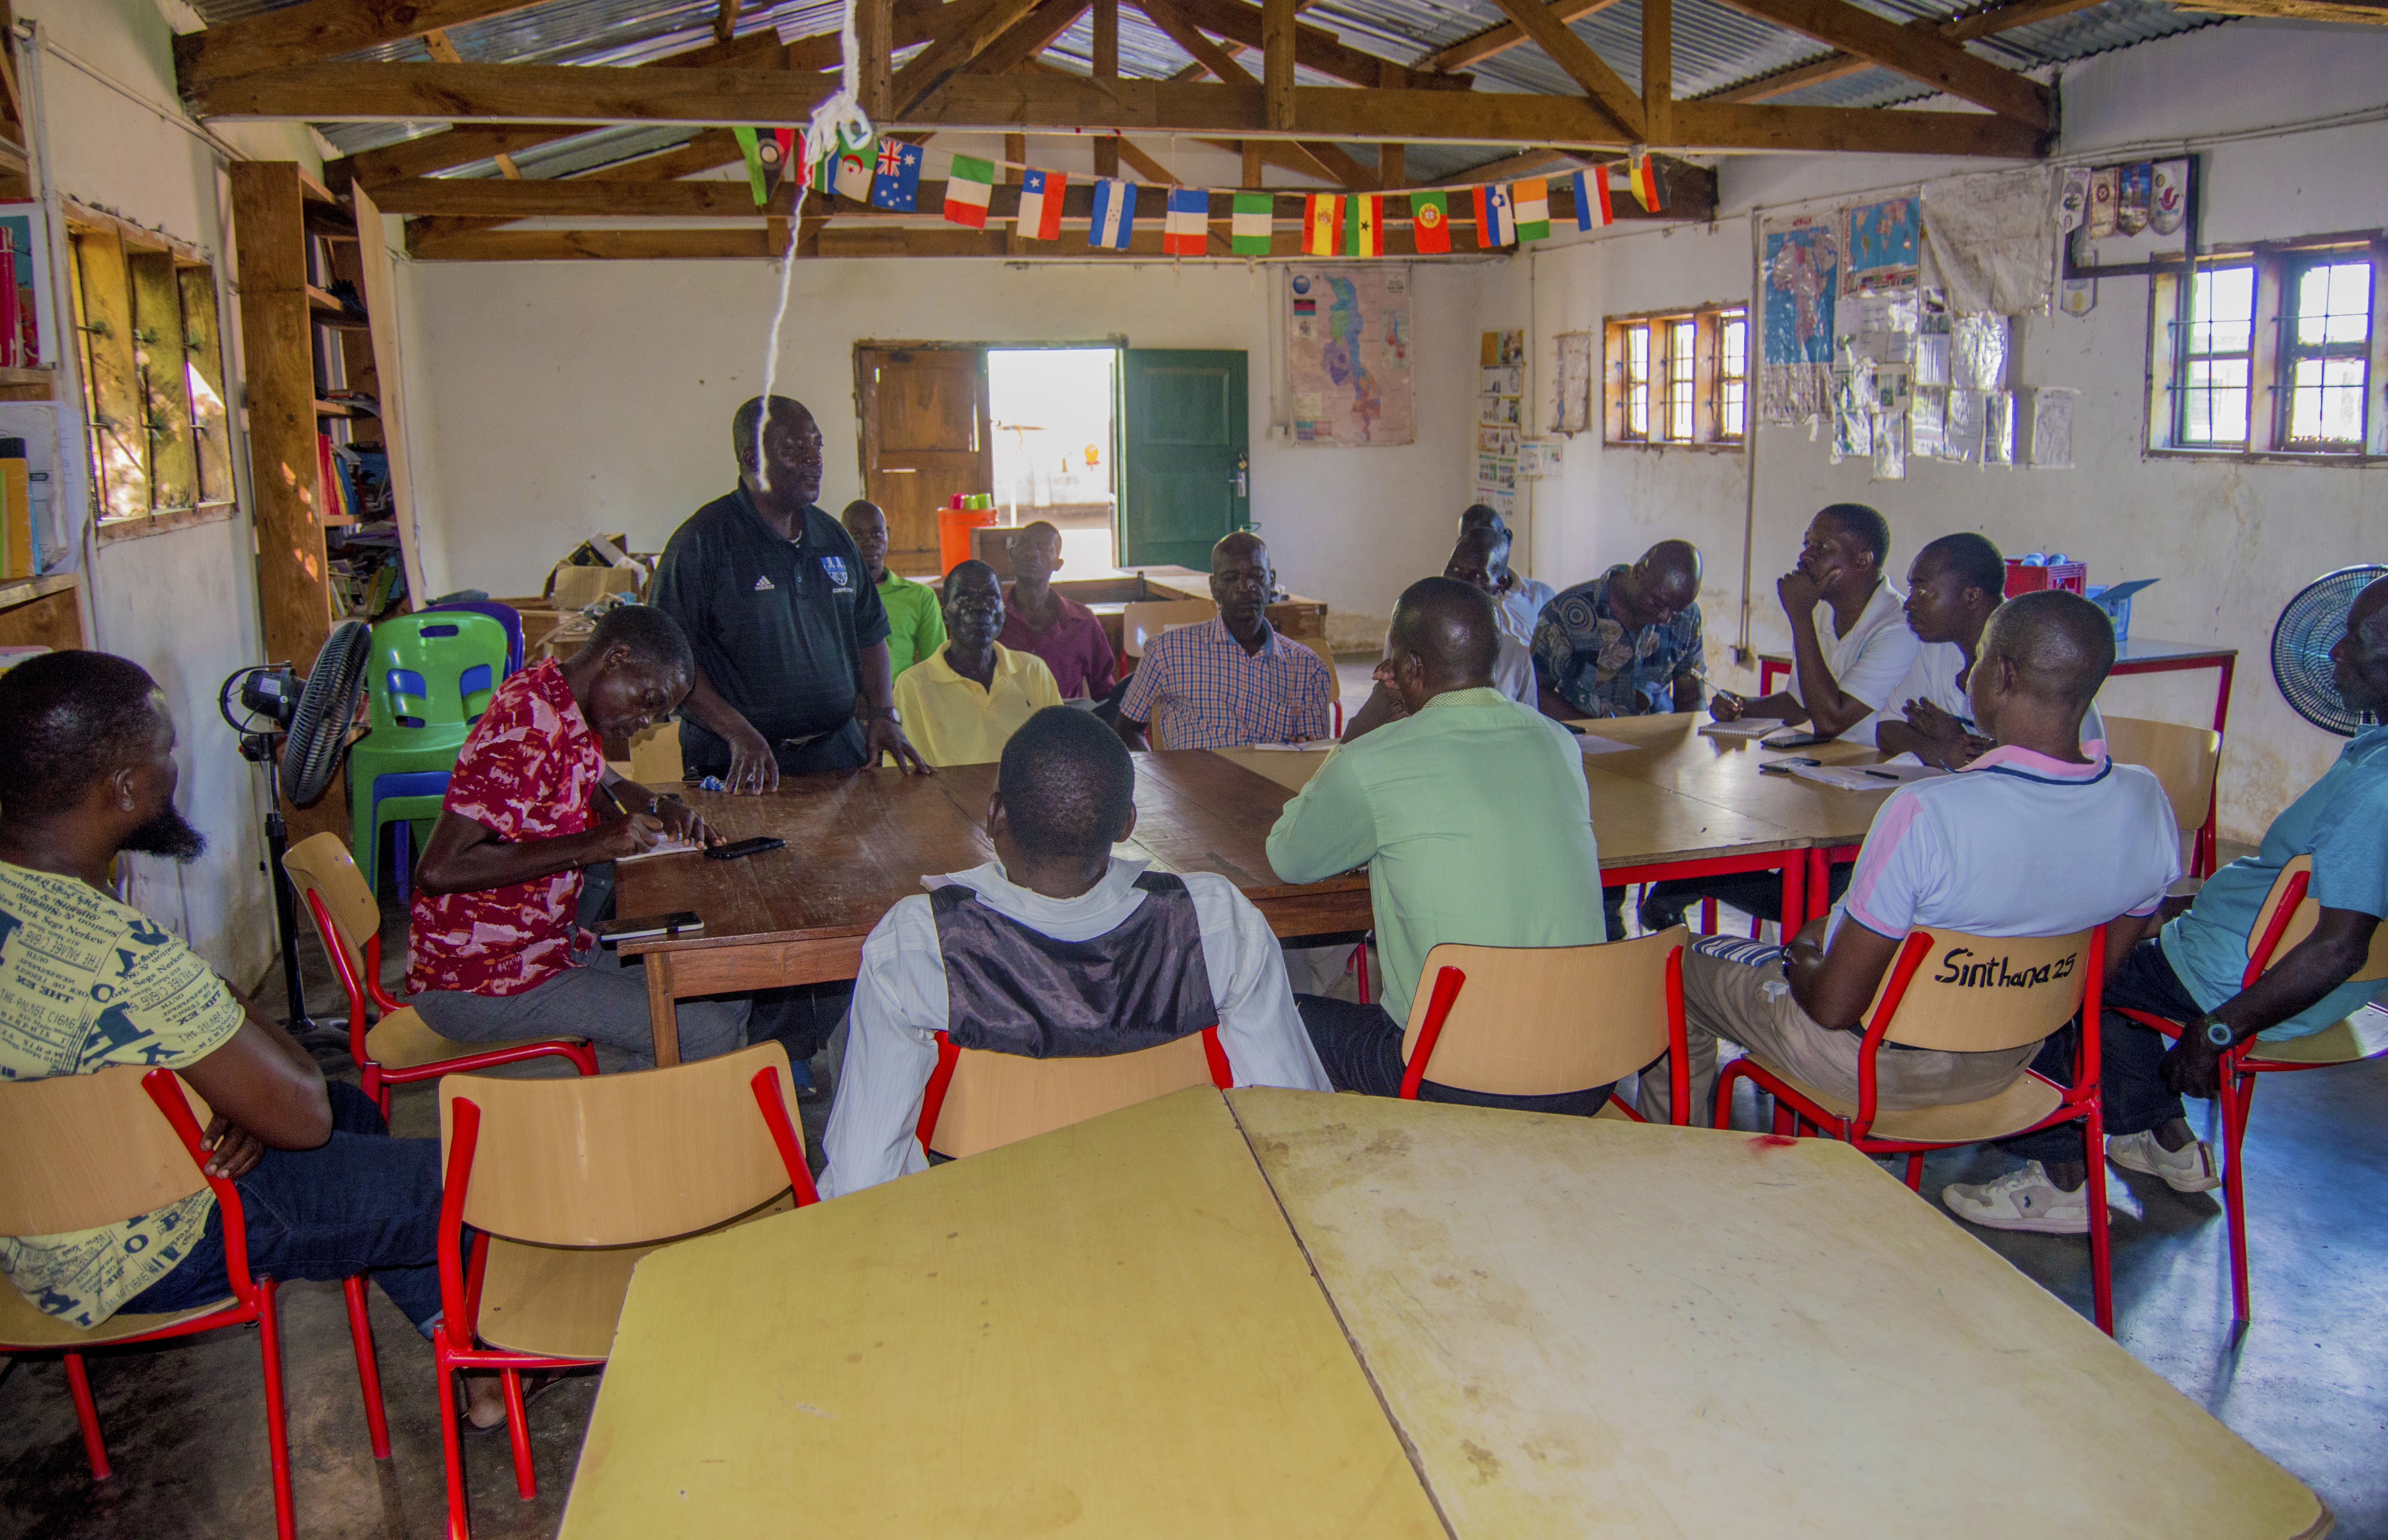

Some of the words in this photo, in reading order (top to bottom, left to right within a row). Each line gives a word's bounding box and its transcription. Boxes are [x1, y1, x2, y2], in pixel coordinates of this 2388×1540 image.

[1793, 217, 1812, 226] AFRICA
[18, 903, 38, 919] York
[82, 953, 102, 968] THE
[1934, 947, 2051, 988] Sinthana
[2052, 953, 2077, 979] 25
